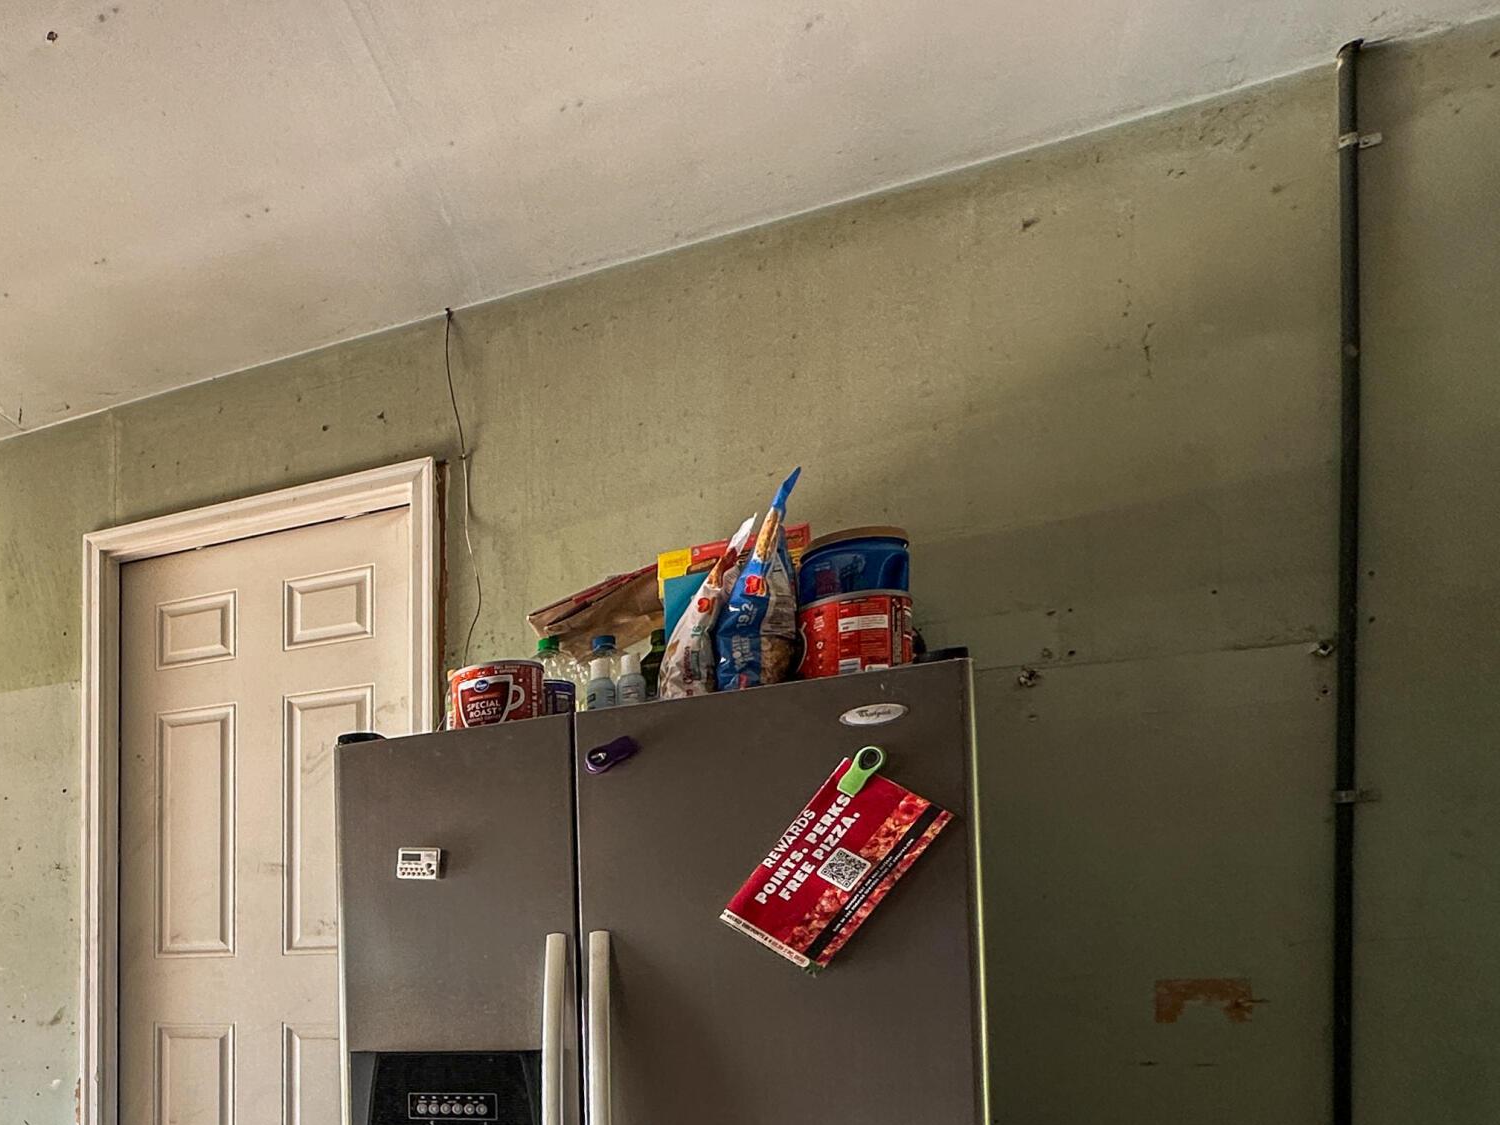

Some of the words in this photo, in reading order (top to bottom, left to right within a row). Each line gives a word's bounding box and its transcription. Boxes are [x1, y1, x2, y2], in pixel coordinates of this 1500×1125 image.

[466, 699, 501, 712] SPECIAL
[469, 707, 497, 719] ROAST
[762, 809, 816, 869] REWARDS
[778, 861, 816, 902] FREE
[814, 811, 861, 860] PIZZA.
[754, 847, 809, 905] POINTS.
